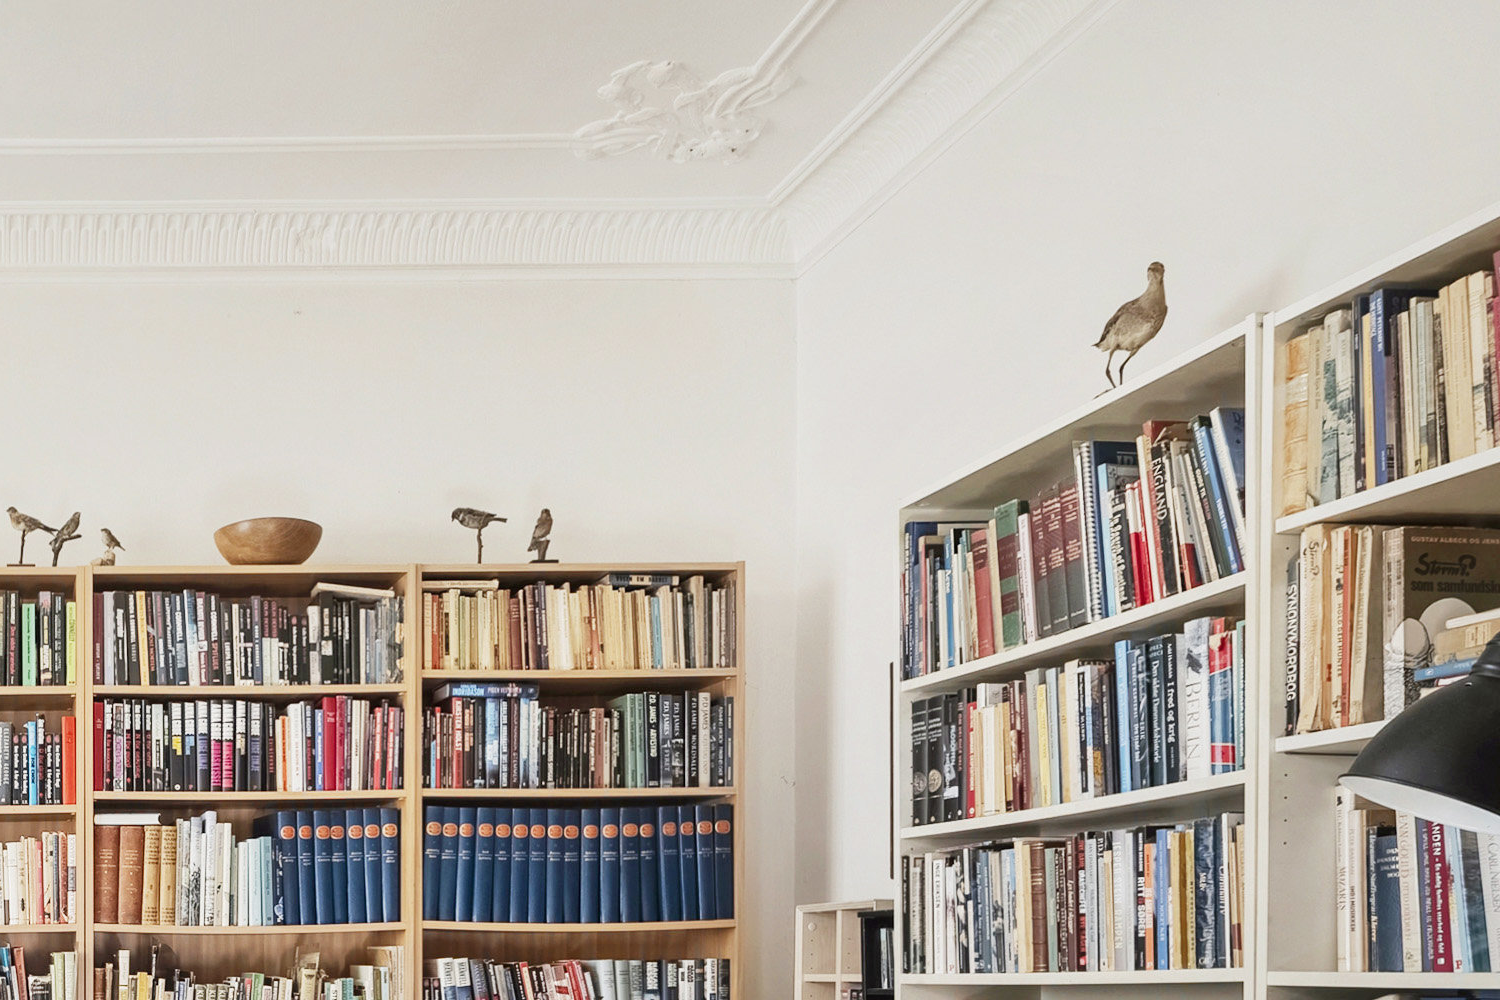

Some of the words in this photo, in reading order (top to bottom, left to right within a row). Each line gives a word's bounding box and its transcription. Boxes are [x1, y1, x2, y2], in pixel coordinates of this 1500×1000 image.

[1150, 457, 1168, 521] ENGLAND
[1286, 583, 1299, 702] SYNONYMORDBOG
[455, 700, 463, 728] KIRSTEN
[649, 706, 658, 723] JAMES
[1185, 681, 1202, 760] BERLIN
[455, 730, 463, 751] HOLST
[1152, 698, 1163, 763] Danmarkshistorie
[1487, 842, 1499, 869] CARL
[1137, 877, 1145, 897] RITT
[1489, 872, 1500, 913] NIELSEN
[1137, 905, 1146, 937] SØREN
